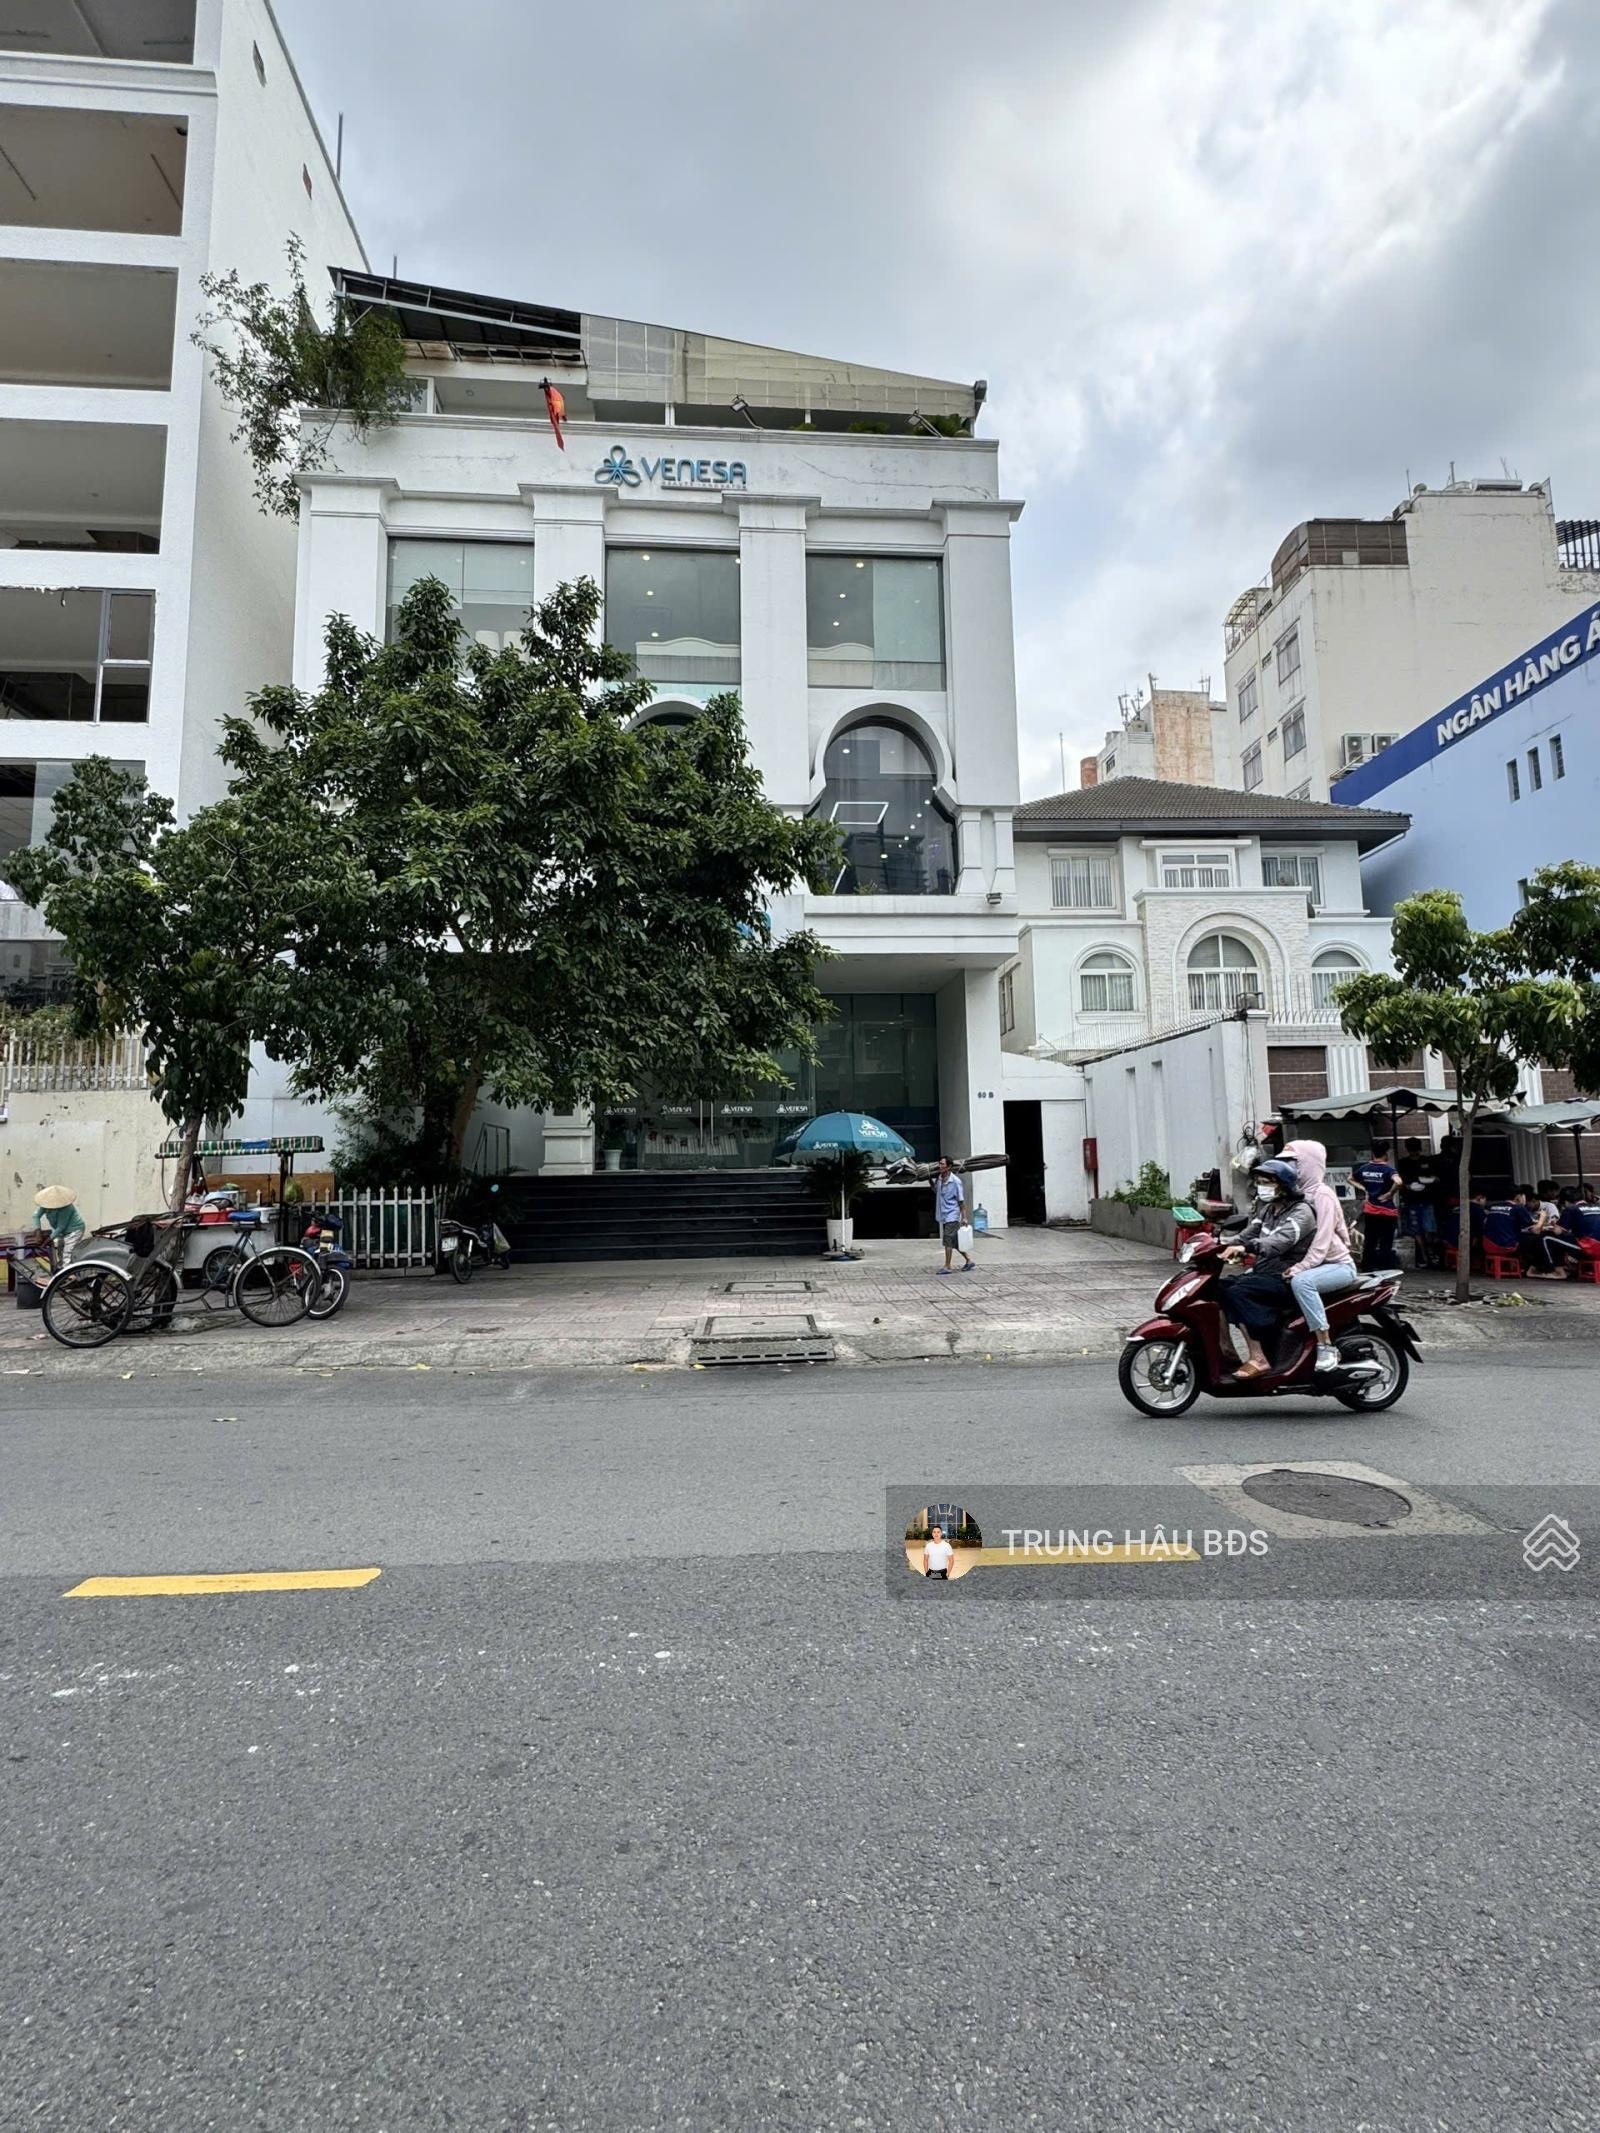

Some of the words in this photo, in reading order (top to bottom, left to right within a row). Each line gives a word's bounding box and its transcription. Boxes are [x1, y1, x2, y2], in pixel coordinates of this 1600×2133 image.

[641, 457, 747, 484] VENESA
[1437, 687, 1502, 746] NGÂN
[1504, 635, 1581, 703] HÀNG
